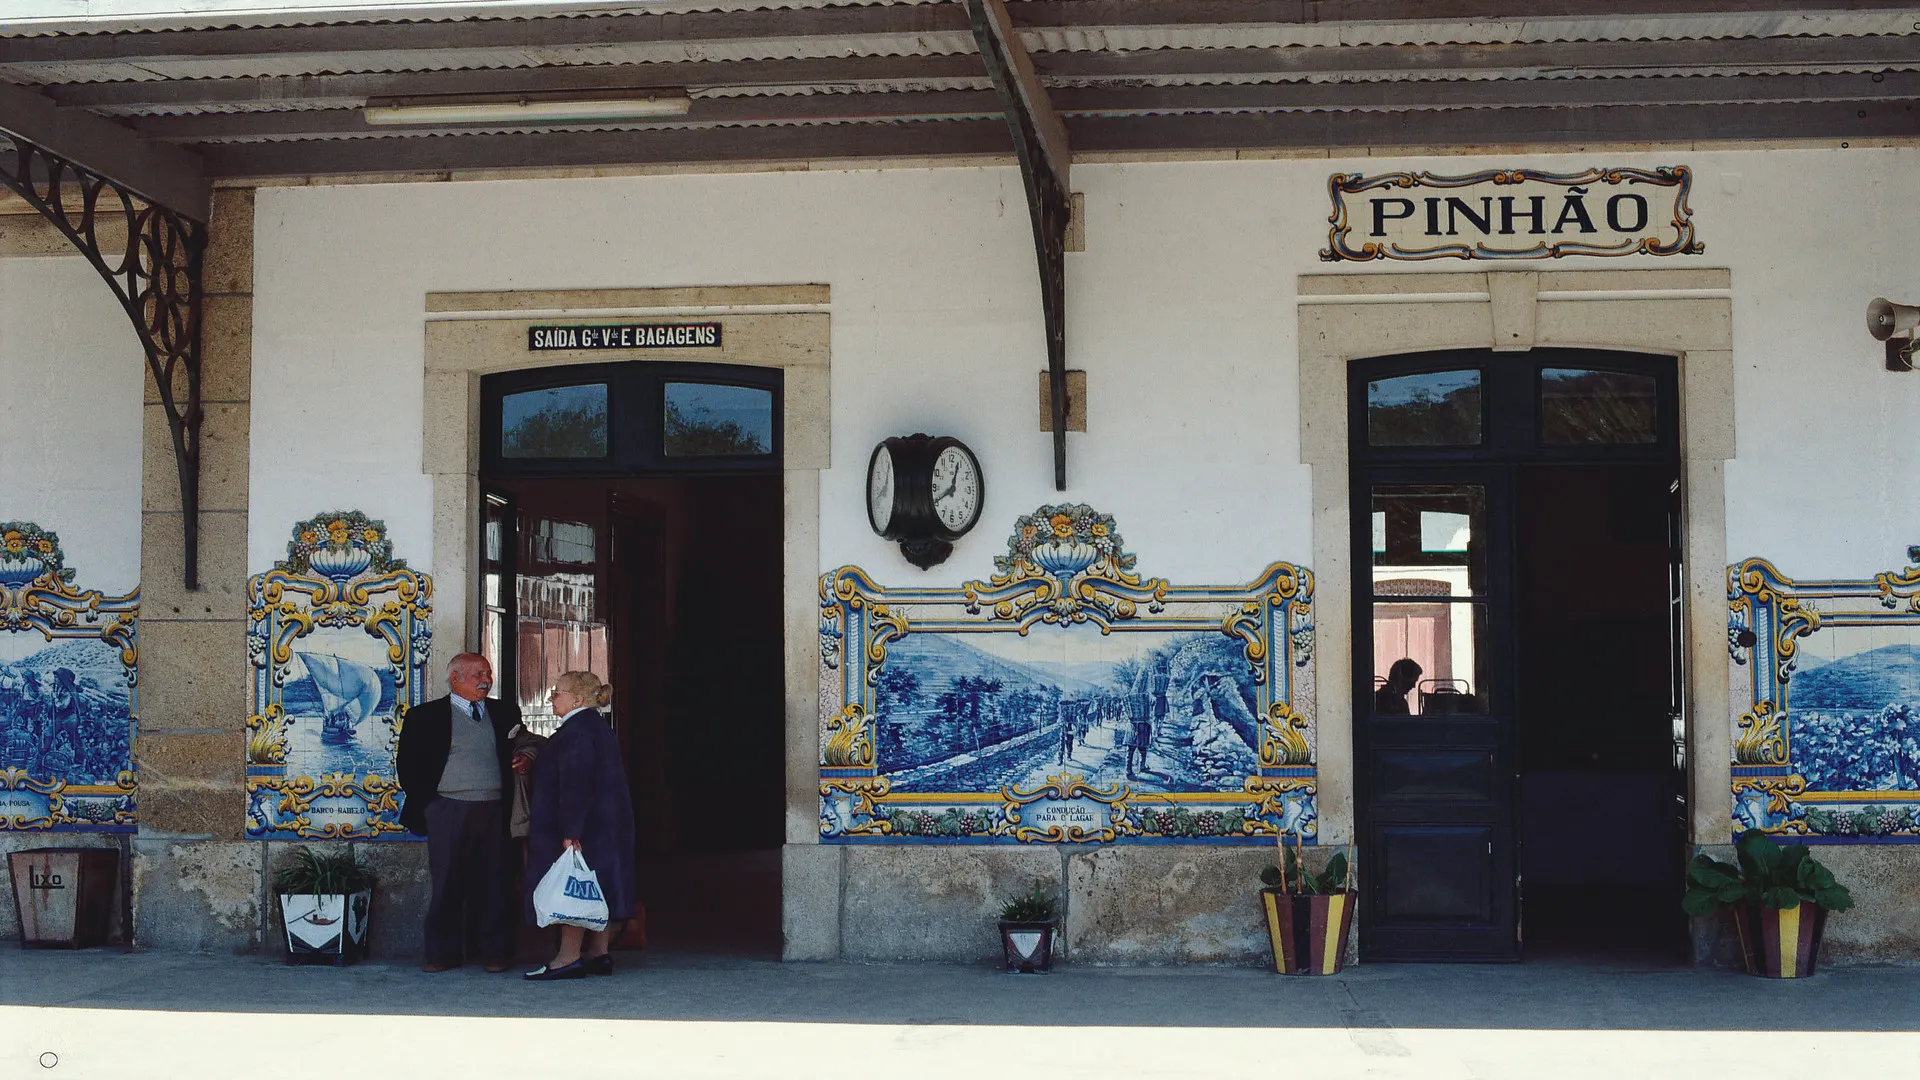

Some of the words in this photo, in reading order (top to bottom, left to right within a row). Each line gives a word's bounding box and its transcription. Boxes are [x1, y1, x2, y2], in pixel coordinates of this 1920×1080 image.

[1369, 187, 1648, 236] PINHÃO
[534, 327, 577, 347] SAÍDA
[621, 328, 631, 346] E
[635, 326, 715, 346] BAGAGENS
[1046, 804, 1086, 814] CONDUÇÃO
[29, 865, 65, 889] LIXO
